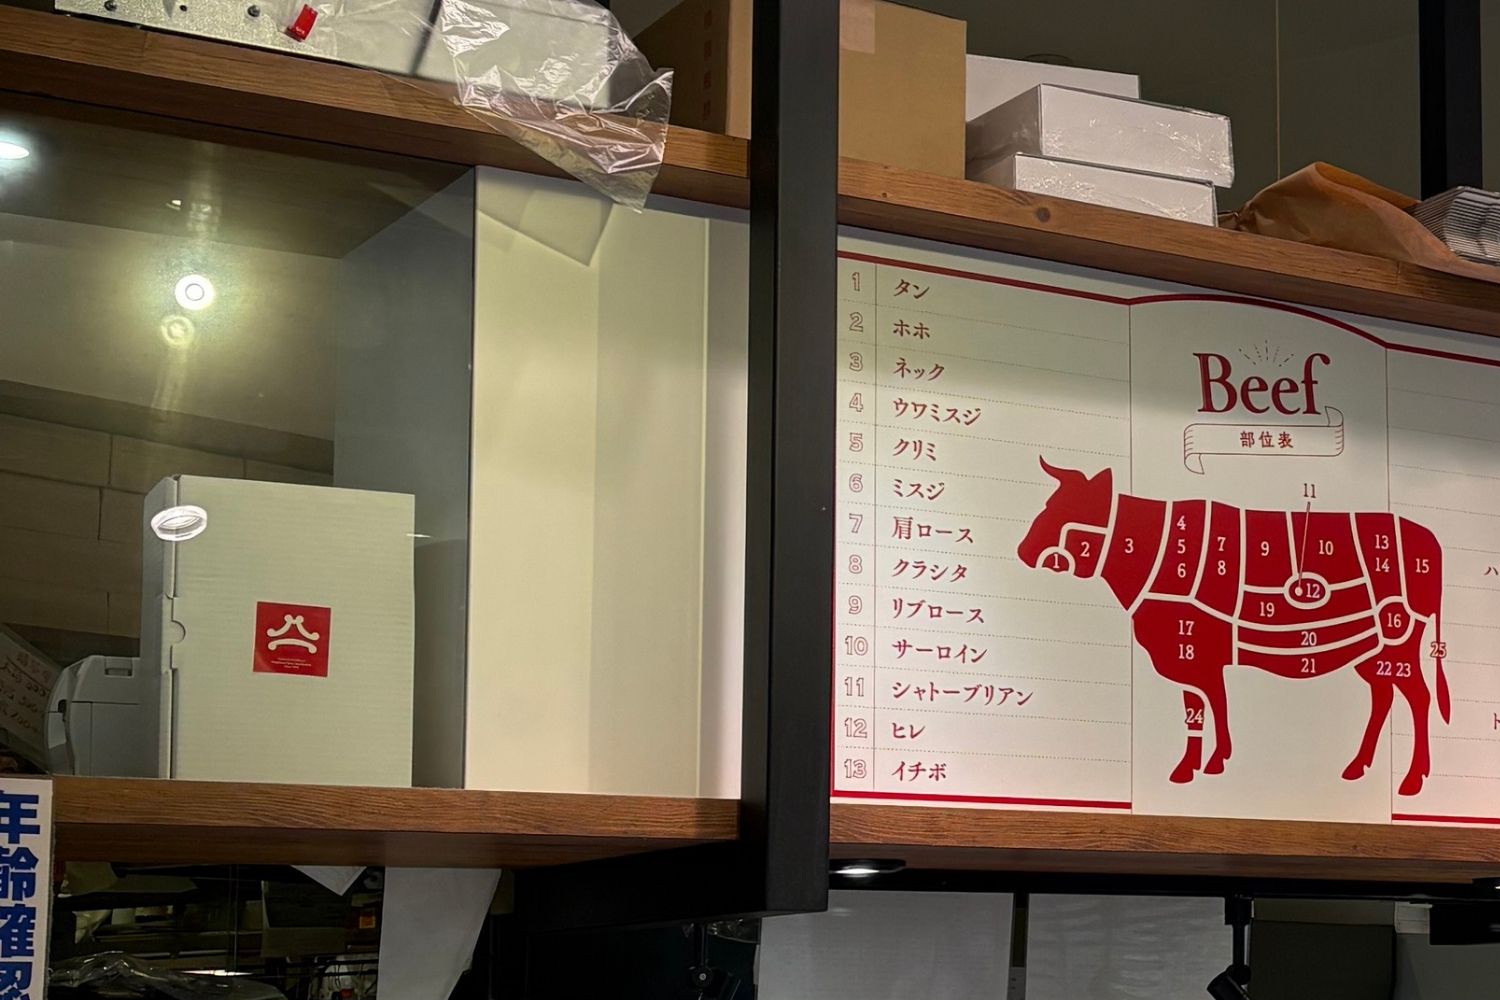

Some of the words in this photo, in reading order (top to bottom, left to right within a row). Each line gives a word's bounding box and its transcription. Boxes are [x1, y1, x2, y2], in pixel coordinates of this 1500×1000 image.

[852, 272, 860, 291] 1
[894, 279, 930, 299] タン
[849, 312, 864, 332] 2
[893, 319, 931, 339] ホホ
[849, 352, 864, 372] 3
[895, 358, 945, 381] ネック
[1193, 352, 1331, 416] Beef
[849, 393, 864, 412] 4
[893, 398, 982, 425] ウワミスジ
[849, 433, 863, 452] 5
[893, 438, 937, 461] クリミ
[1239, 431, 1295, 450] 部位表
[849, 473, 863, 492] 6
[893, 481, 945, 500] ミスジ
[1303, 483, 1317, 499] 11
[849, 513, 863, 533] 7
[892, 516, 974, 543] 肩ロース
[1176, 515, 1187, 531] 4
[1080, 541, 1091, 557] 2
[1124, 538, 1135, 554] 3
[1176, 538, 1187, 555] 5
[1217, 536, 1227, 552] 7
[1260, 541, 1271, 557] 9
[1318, 540, 1334, 556] 10
[1374, 534, 1390, 550] 13
[848, 555, 863, 574] 8
[892, 558, 967, 582] クラシタ
[1053, 554, 1061, 570] 1
[1176, 562, 1187, 578] 6
[1217, 560, 1227, 576] 8
[1374, 557, 1390, 573] 14
[1414, 558, 1430, 574] 15
[1305, 583, 1321, 599] 12
[849, 595, 863, 615] 9
[892, 598, 984, 624] リブロース
[1259, 602, 1275, 618] 19
[1178, 620, 1194, 636] 17
[1386, 613, 1402, 629] 16
[1301, 631, 1317, 647] 20
[845, 636, 868, 656] 10
[892, 640, 988, 663] サーロイン
[1178, 644, 1194, 660] 18
[1430, 641, 1447, 659] 25
[1301, 658, 1317, 674] 21
[1376, 661, 1392, 677] 22
[1396, 661, 1412, 677] 23
[845, 677, 864, 697] 11
[891, 681, 1034, 707] シャトーブリアン
[1185, 708, 1204, 725] 24
[845, 717, 868, 738] 12
[892, 721, 926, 739] ヒレ
[844, 759, 867, 779] 13
[892, 761, 947, 782] イチボ
